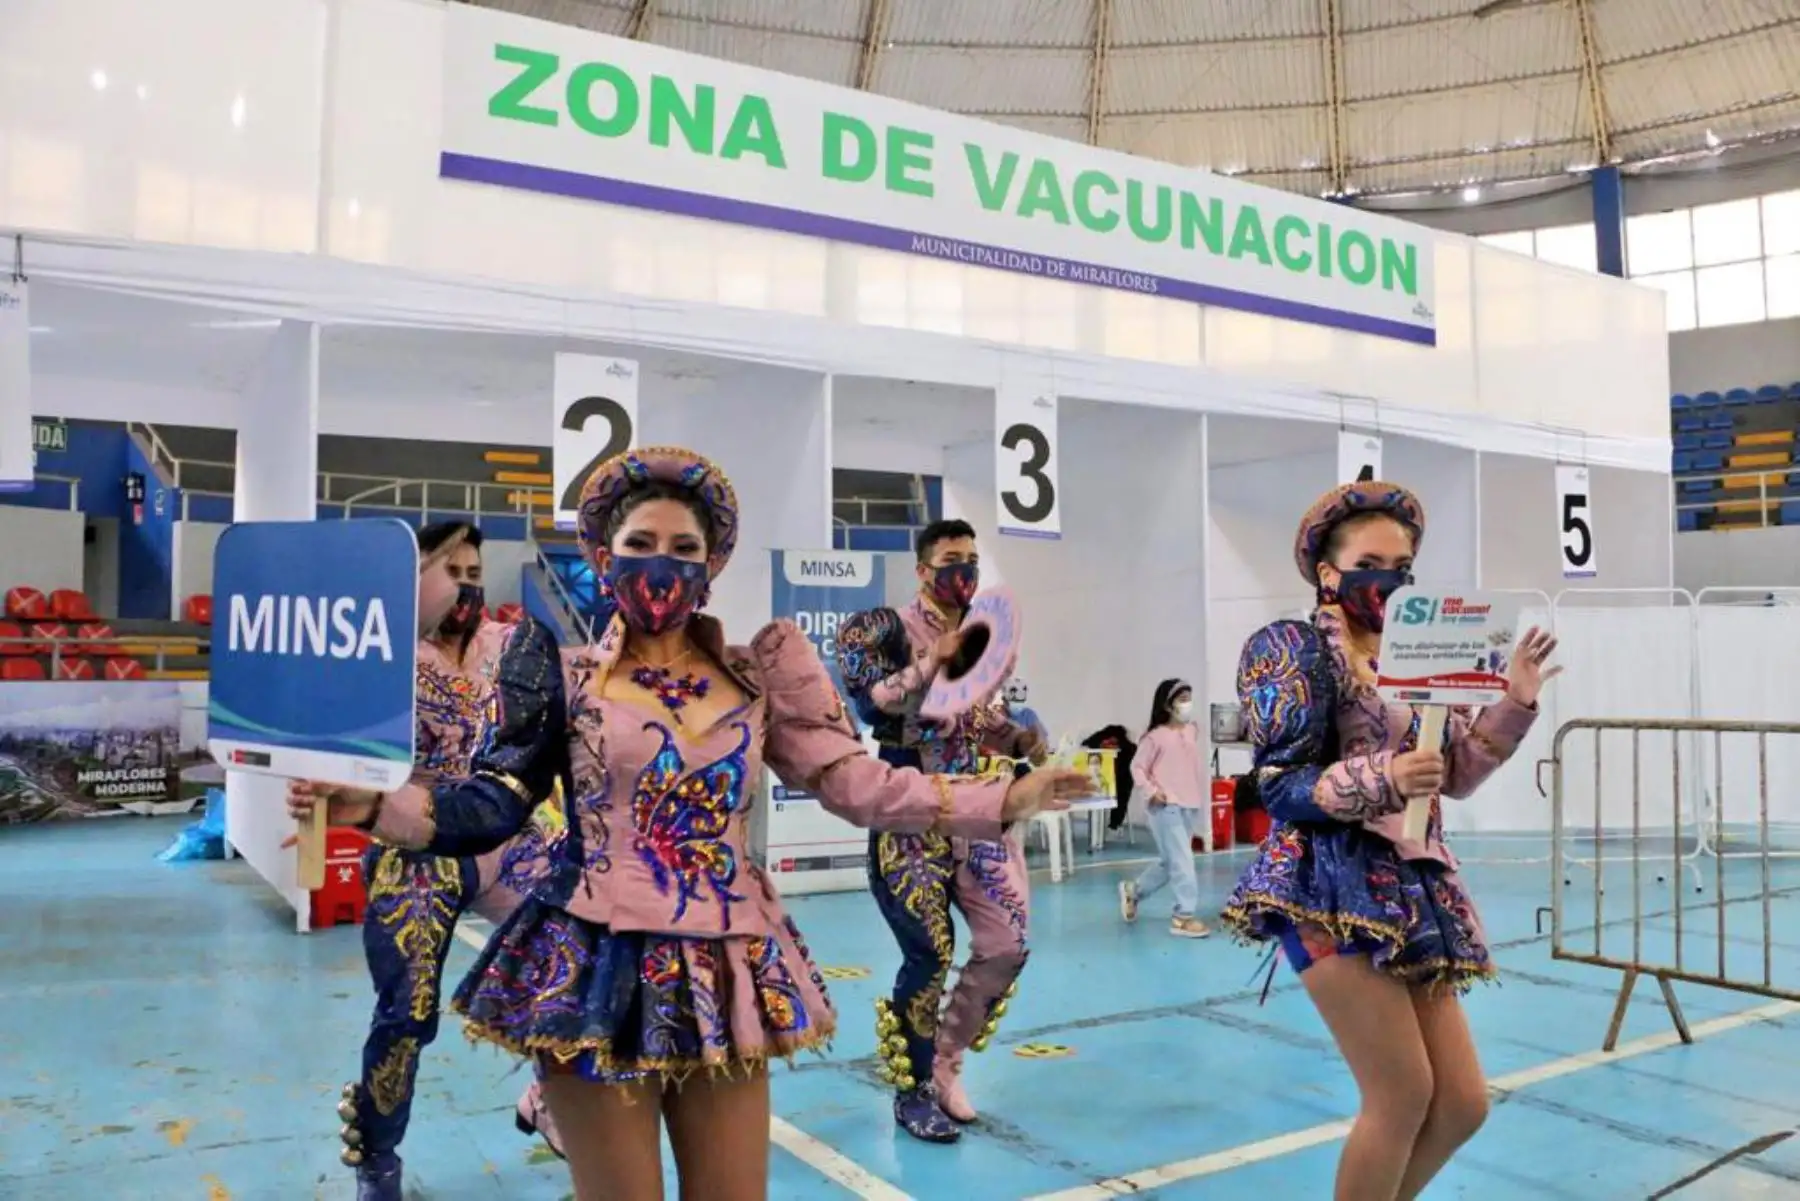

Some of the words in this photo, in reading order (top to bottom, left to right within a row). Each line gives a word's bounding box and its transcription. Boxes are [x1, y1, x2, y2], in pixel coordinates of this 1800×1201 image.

[487, 43, 787, 169] ZONA
[821, 111, 935, 198] DE
[963, 142, 1419, 297] VACUNACION
[911, 236, 1042, 273] MUNICIPALIDAD
[1046, 258, 1066, 277] DE
[1070, 265, 1158, 293] MIRAFLORES
[560, 396, 633, 511] 2
[1000, 422, 1055, 523] 3
[1563, 493, 1592, 567] 5
[800, 560, 857, 578] MINSA
[228, 593, 394, 662] MINSA
[77, 767, 167, 784] MIRAFLORES
[95, 781, 167, 796] MODERNA
